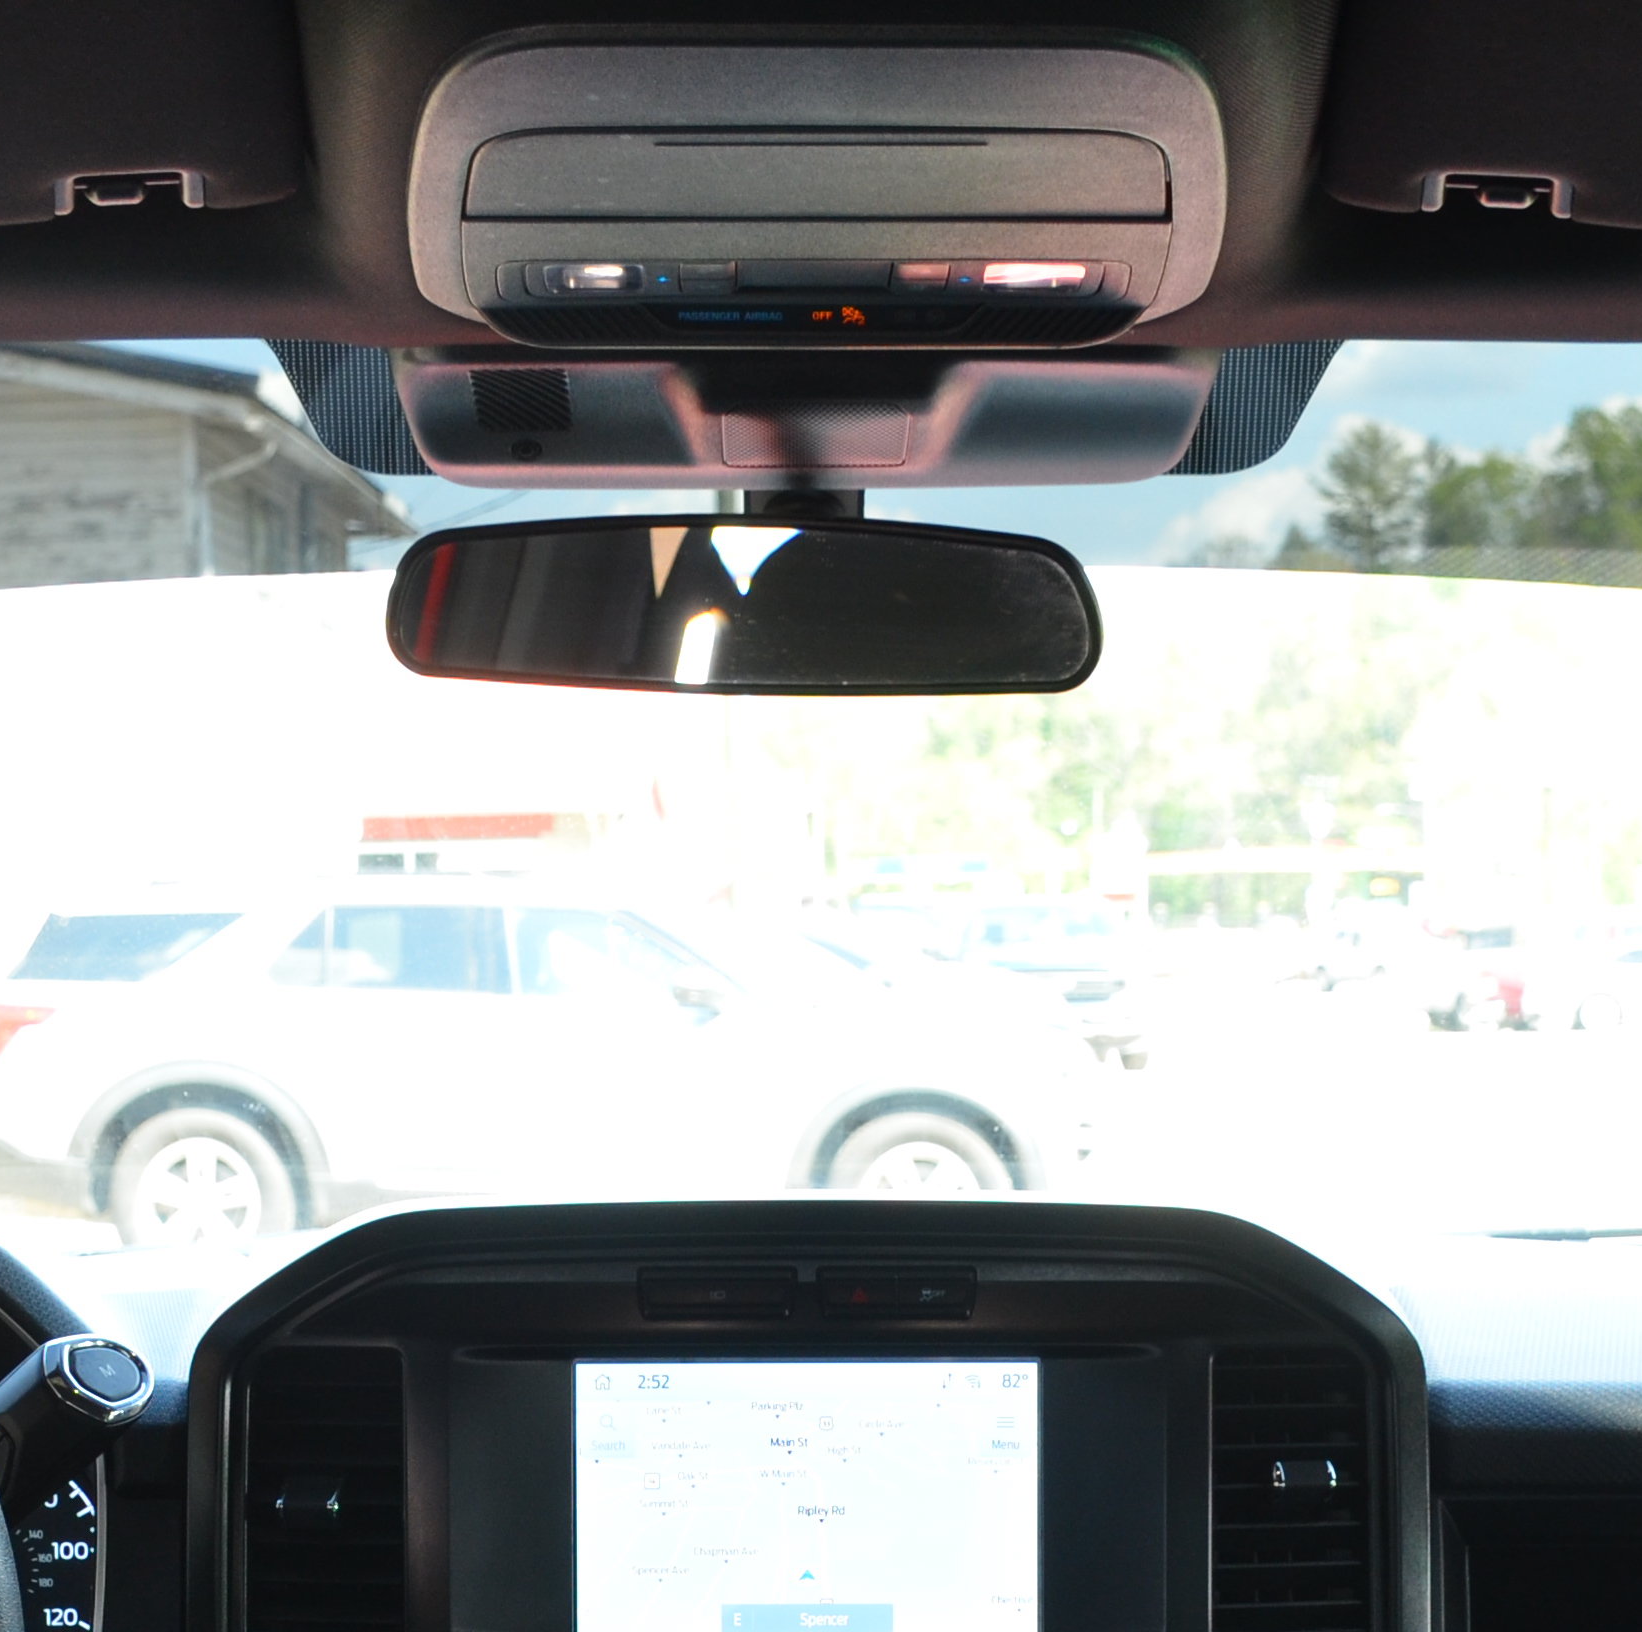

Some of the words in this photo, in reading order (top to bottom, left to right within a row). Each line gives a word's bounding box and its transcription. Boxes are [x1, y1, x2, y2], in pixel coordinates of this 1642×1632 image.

[678, 311, 740, 321] PASSENGER
[812, 311, 833, 321] OFF
[637, 1374, 670, 1389] 2:52
[592, 1440, 625, 1450] Search
[770, 1437, 795, 1448] Main
[797, 1437, 809, 1448] St
[992, 1439, 1020, 1450] Menu
[797, 1505, 829, 1517] Ripley
[831, 1505, 846, 1515] Rd
[28, 1529, 43, 1540] 140
[51, 1541, 89, 1560] 100
[37, 1553, 53, 1563] 160
[38, 1577, 54, 1588] 180
[43, 1608, 78, 1626] 120
[733, 1612, 742, 1627] E
[799, 1612, 849, 1628] Spencer
